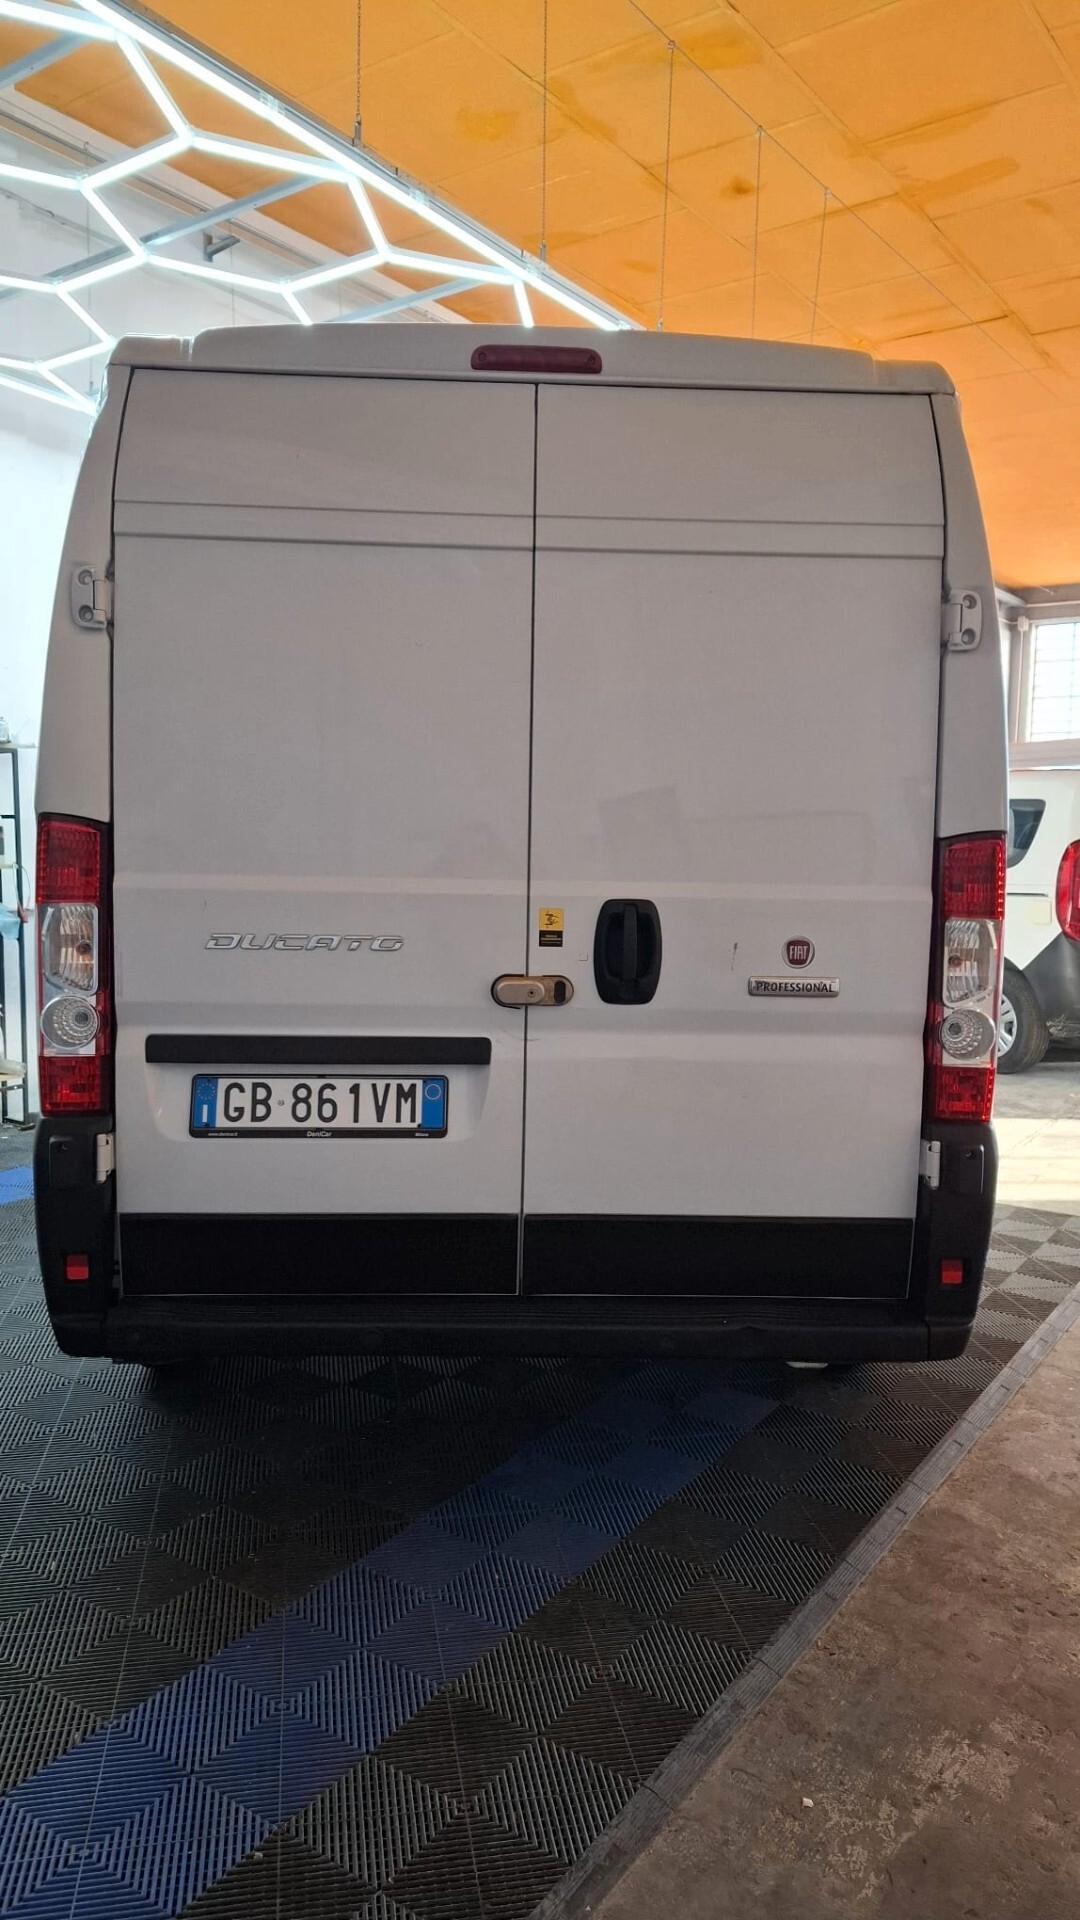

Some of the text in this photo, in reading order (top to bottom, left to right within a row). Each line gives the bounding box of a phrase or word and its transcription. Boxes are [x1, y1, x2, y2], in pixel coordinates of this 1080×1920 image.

[205, 933, 404, 951] DUCATO
[789, 945, 808, 960] FIAT
[755, 980, 834, 993] PROFESSIONAL
[223, 1082, 273, 1123] GB
